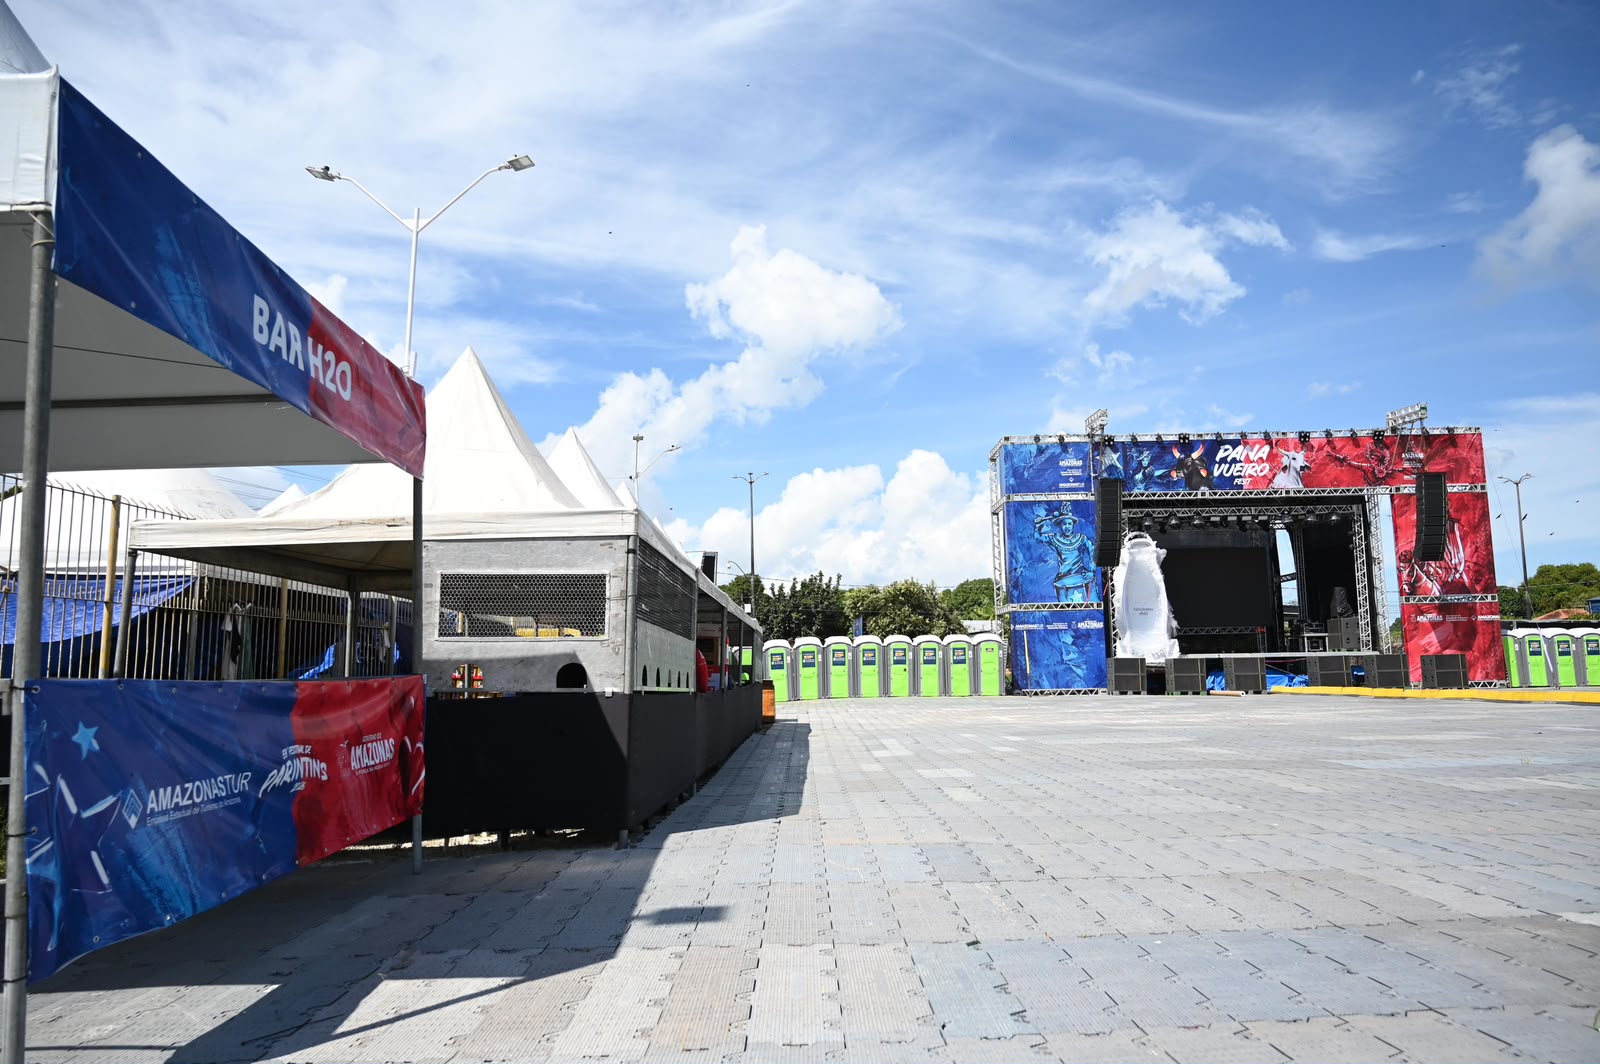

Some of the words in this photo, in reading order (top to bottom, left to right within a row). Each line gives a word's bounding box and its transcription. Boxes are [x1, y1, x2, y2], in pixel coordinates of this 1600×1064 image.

[254, 293, 305, 372] BAR
[1213, 463, 1270, 477] VUEIRO
[1215, 444, 1271, 462] PANA
[351, 738, 394, 770] AMAZONAS
[146, 772, 252, 814] AMAZONASTUR
[259, 756, 328, 798] PARINTINS
